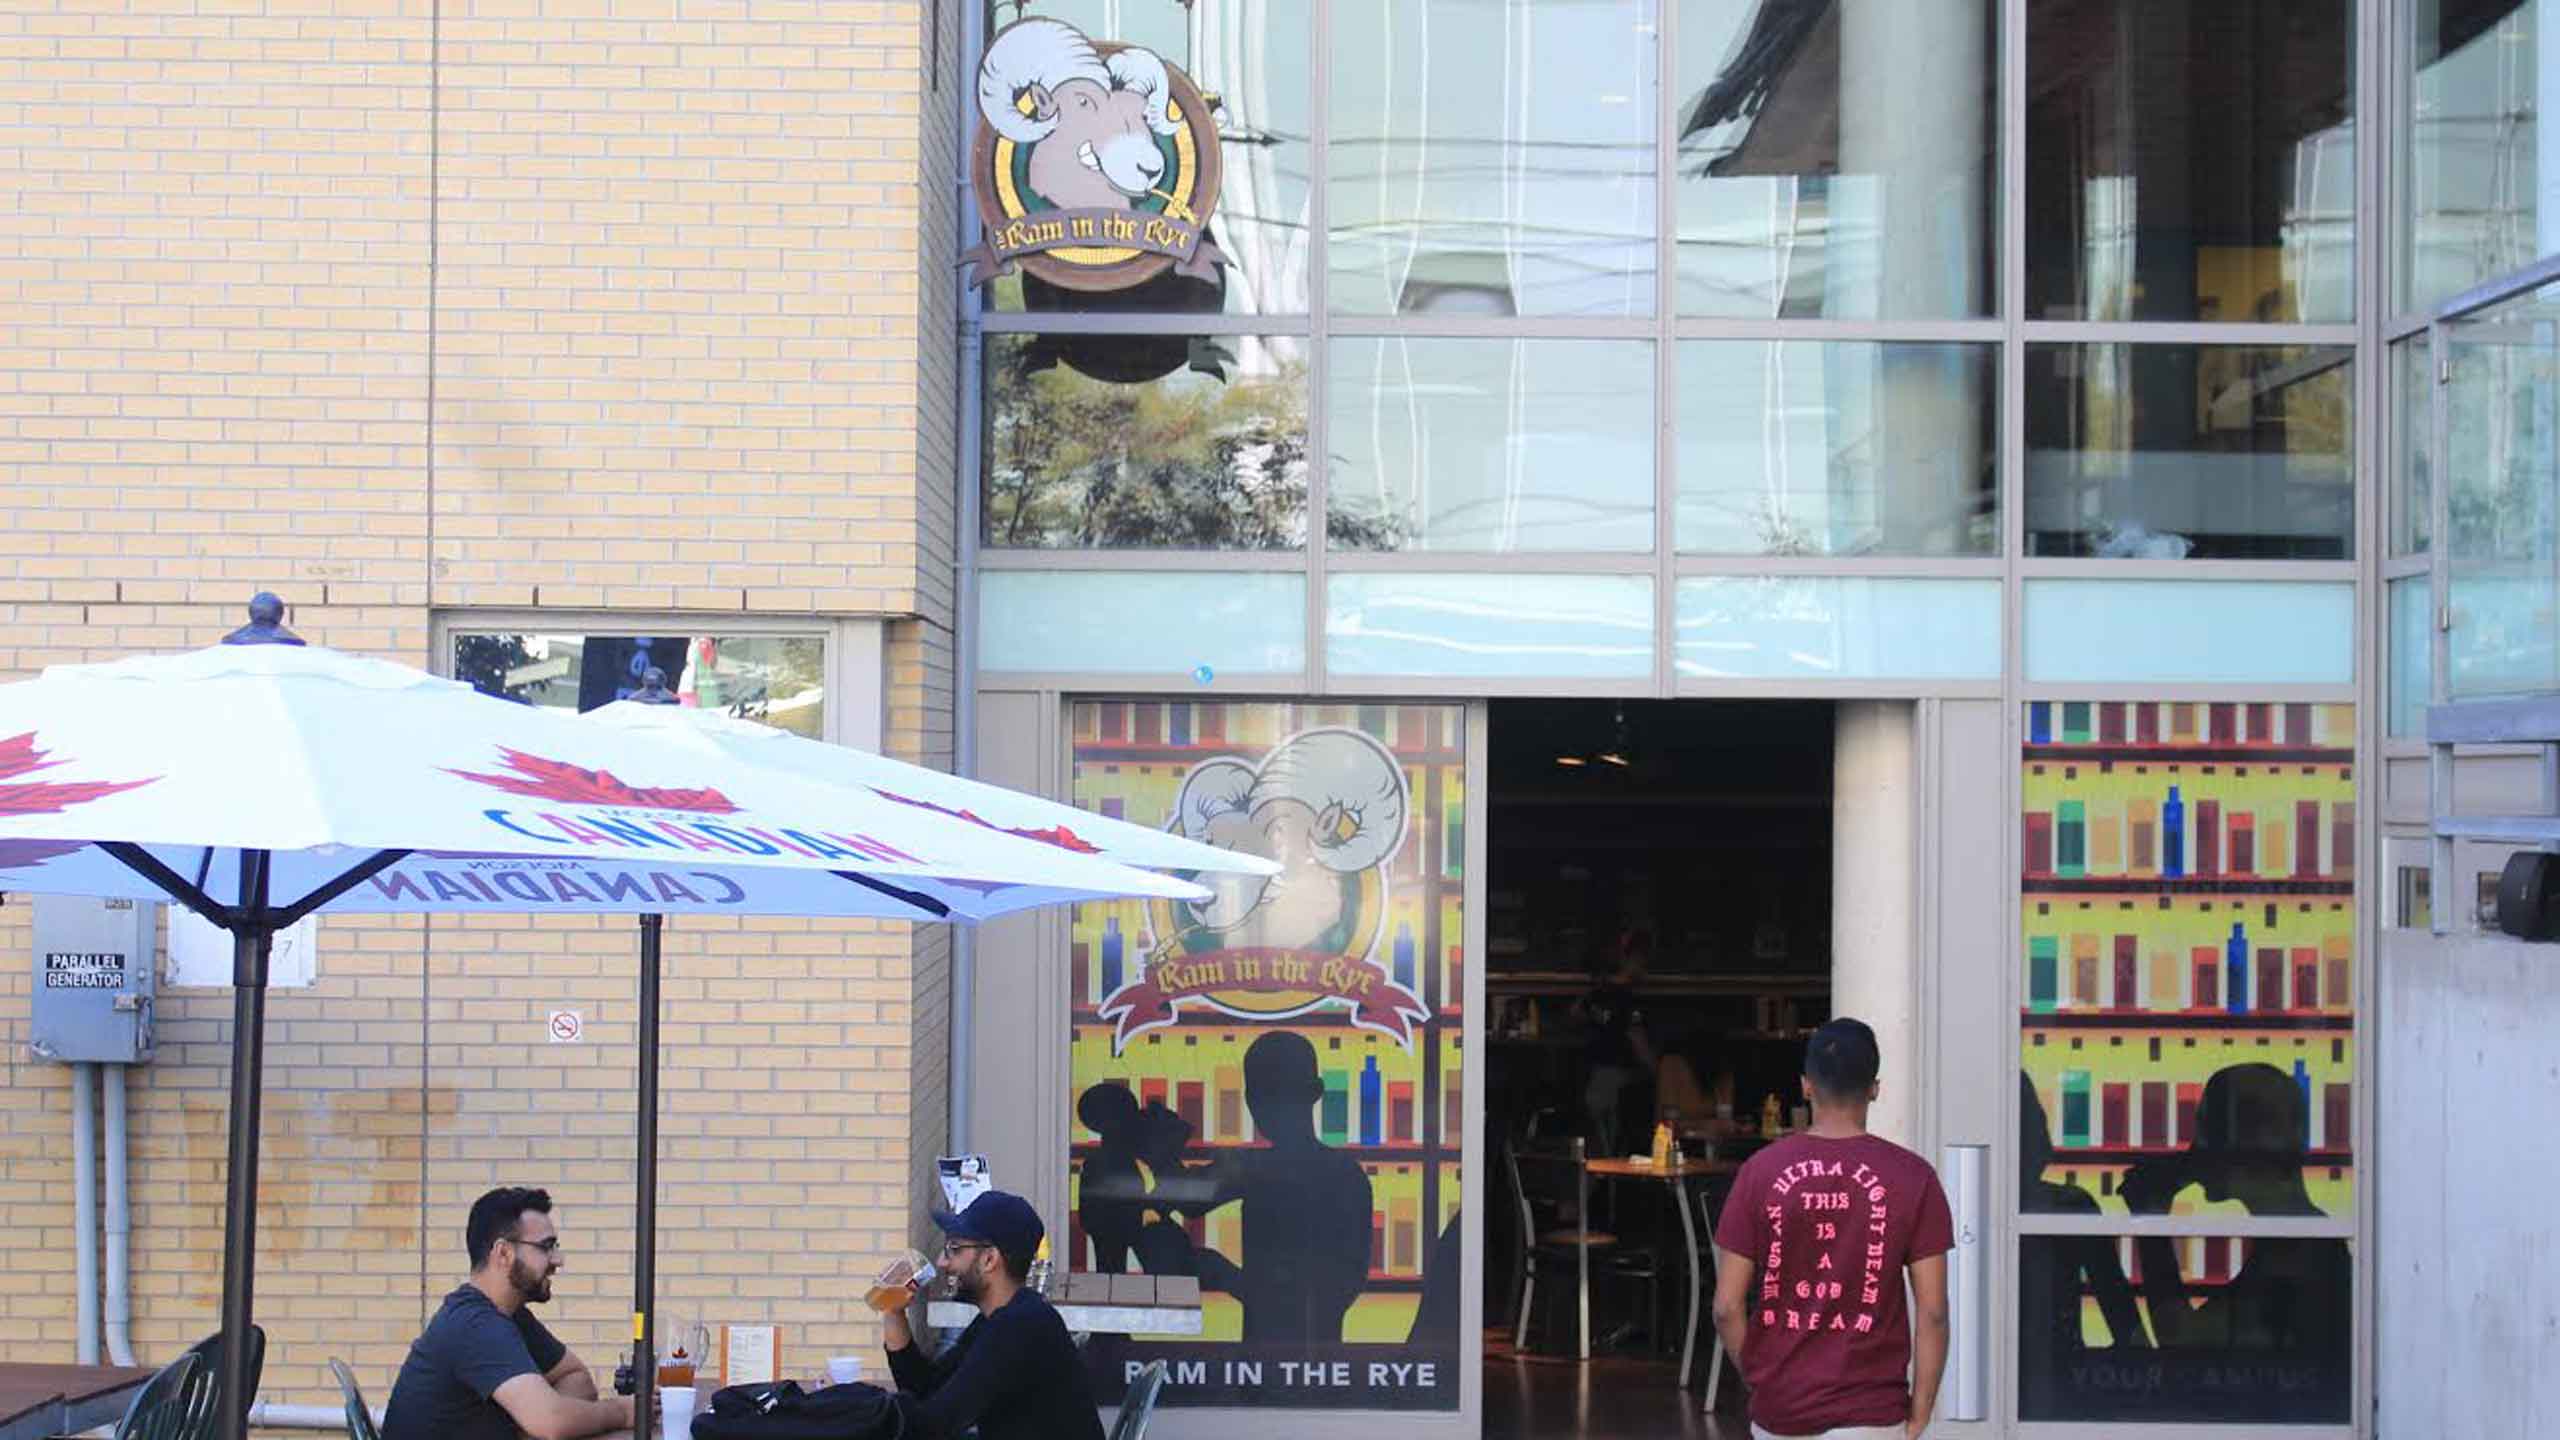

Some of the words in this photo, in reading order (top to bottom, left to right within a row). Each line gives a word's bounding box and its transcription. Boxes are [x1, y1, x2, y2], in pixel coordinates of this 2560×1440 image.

[1004, 214, 1064, 249] Ram
[1070, 215, 1095, 239] in
[1103, 212, 1137, 240] the
[1144, 216, 1191, 249] Rye
[484, 809, 928, 865] CANADIAN
[51, 954, 119, 969] PARALLEL
[48, 973, 122, 987] GENERATOR
[1157, 959, 1225, 994] Ram
[1233, 953, 1261, 982] in
[1271, 954, 1309, 983] the
[1319, 958, 1375, 995] Rye
[1773, 1159, 1844, 1196] ULTRA
[1851, 1163, 1888, 1236] LIGHT
[1800, 1192, 1850, 1210] THIS
[1815, 1223, 1837, 1240] IS
[1816, 1253, 1833, 1270] A
[1795, 1280, 1843, 1299] GOD
[1762, 1309, 1874, 1334] DREAM
[1224, 1361, 1262, 1385] IN
[1279, 1362, 1352, 1386] THE
[1368, 1363, 1436, 1387] RYE
